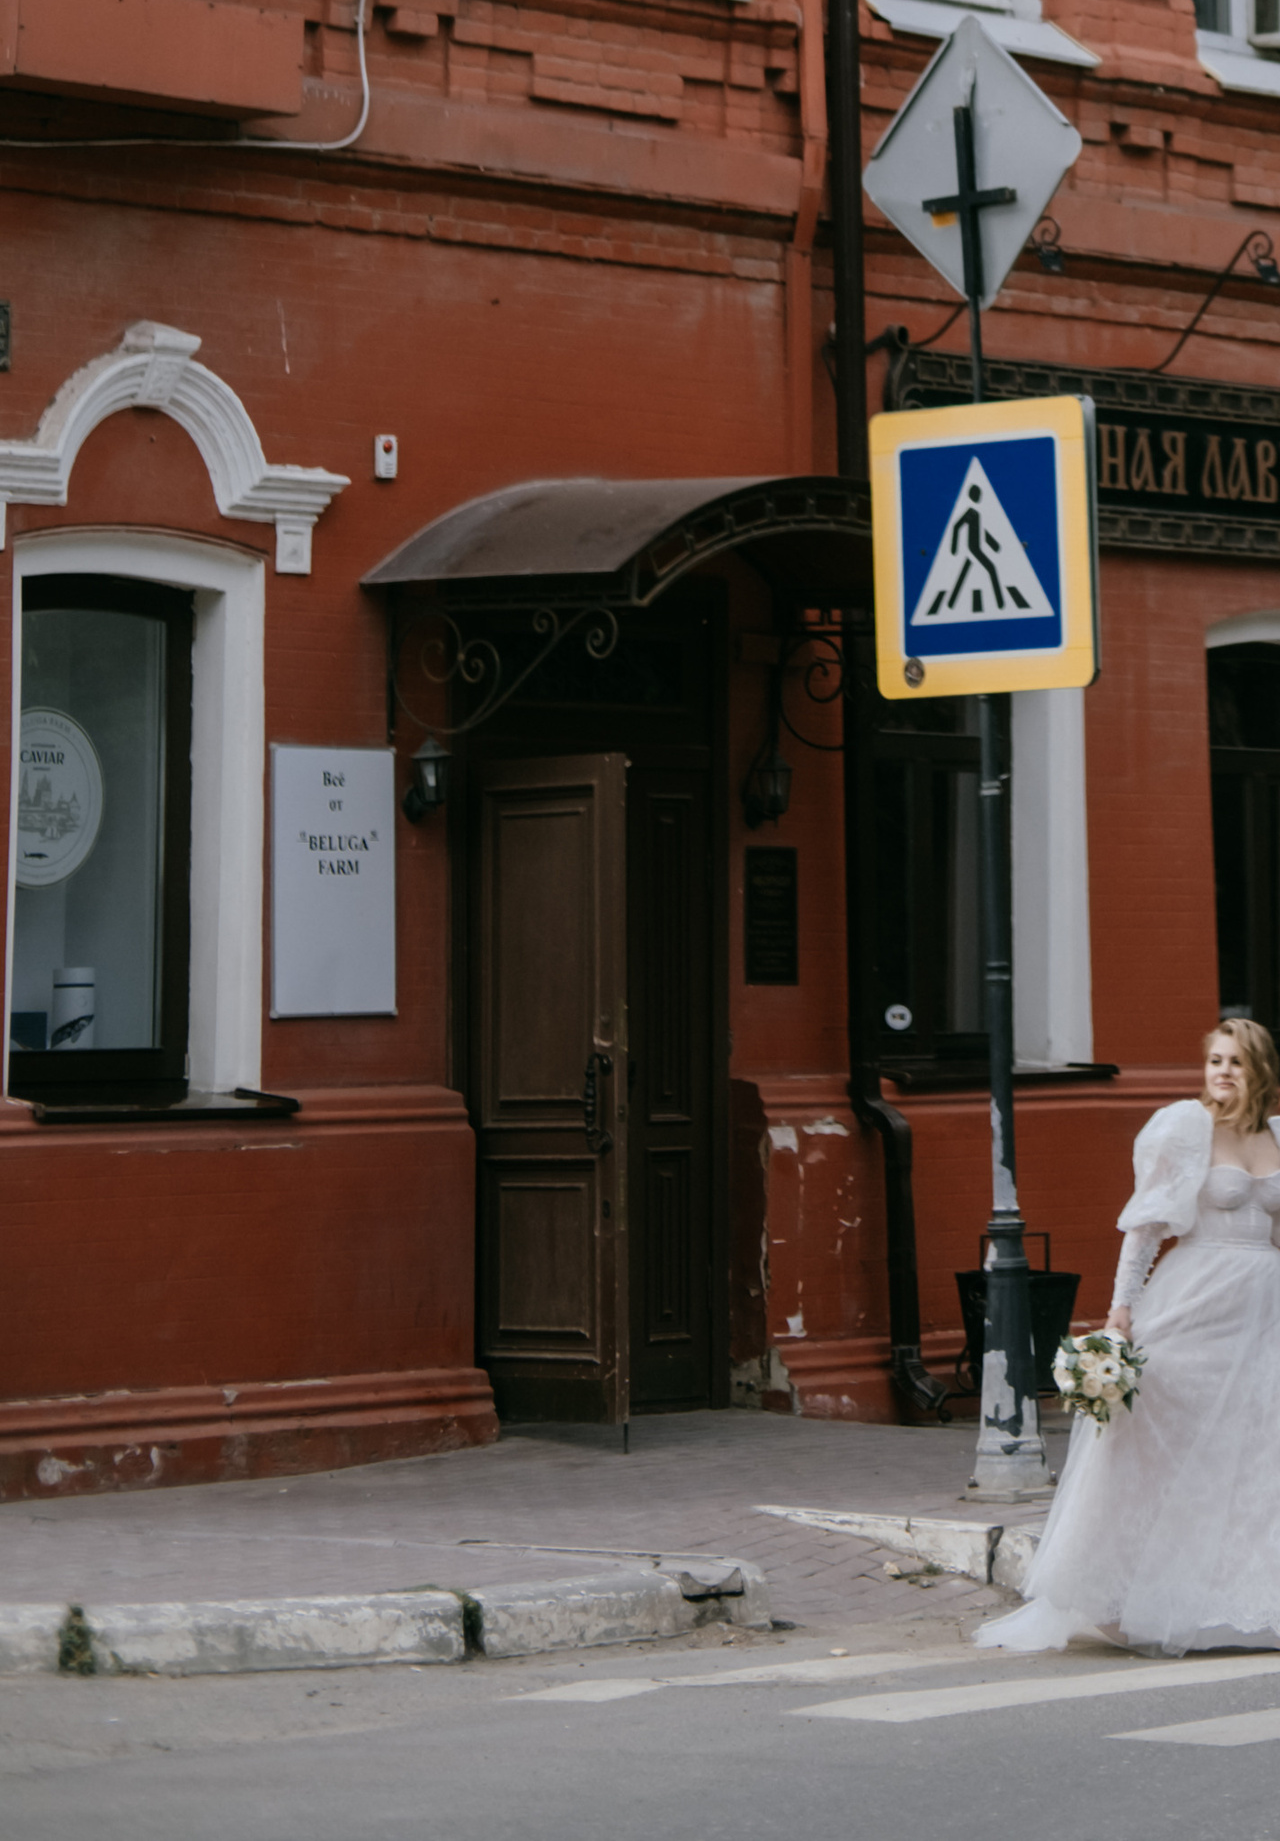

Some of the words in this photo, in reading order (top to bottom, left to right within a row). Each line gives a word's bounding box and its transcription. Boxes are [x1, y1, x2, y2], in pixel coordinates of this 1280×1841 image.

[1097, 423, 1189, 496] НАЯ
[20, 749, 66, 766] CAVIAR
[322, 770, 346, 788] Всё
[317, 858, 361, 877] FARM
